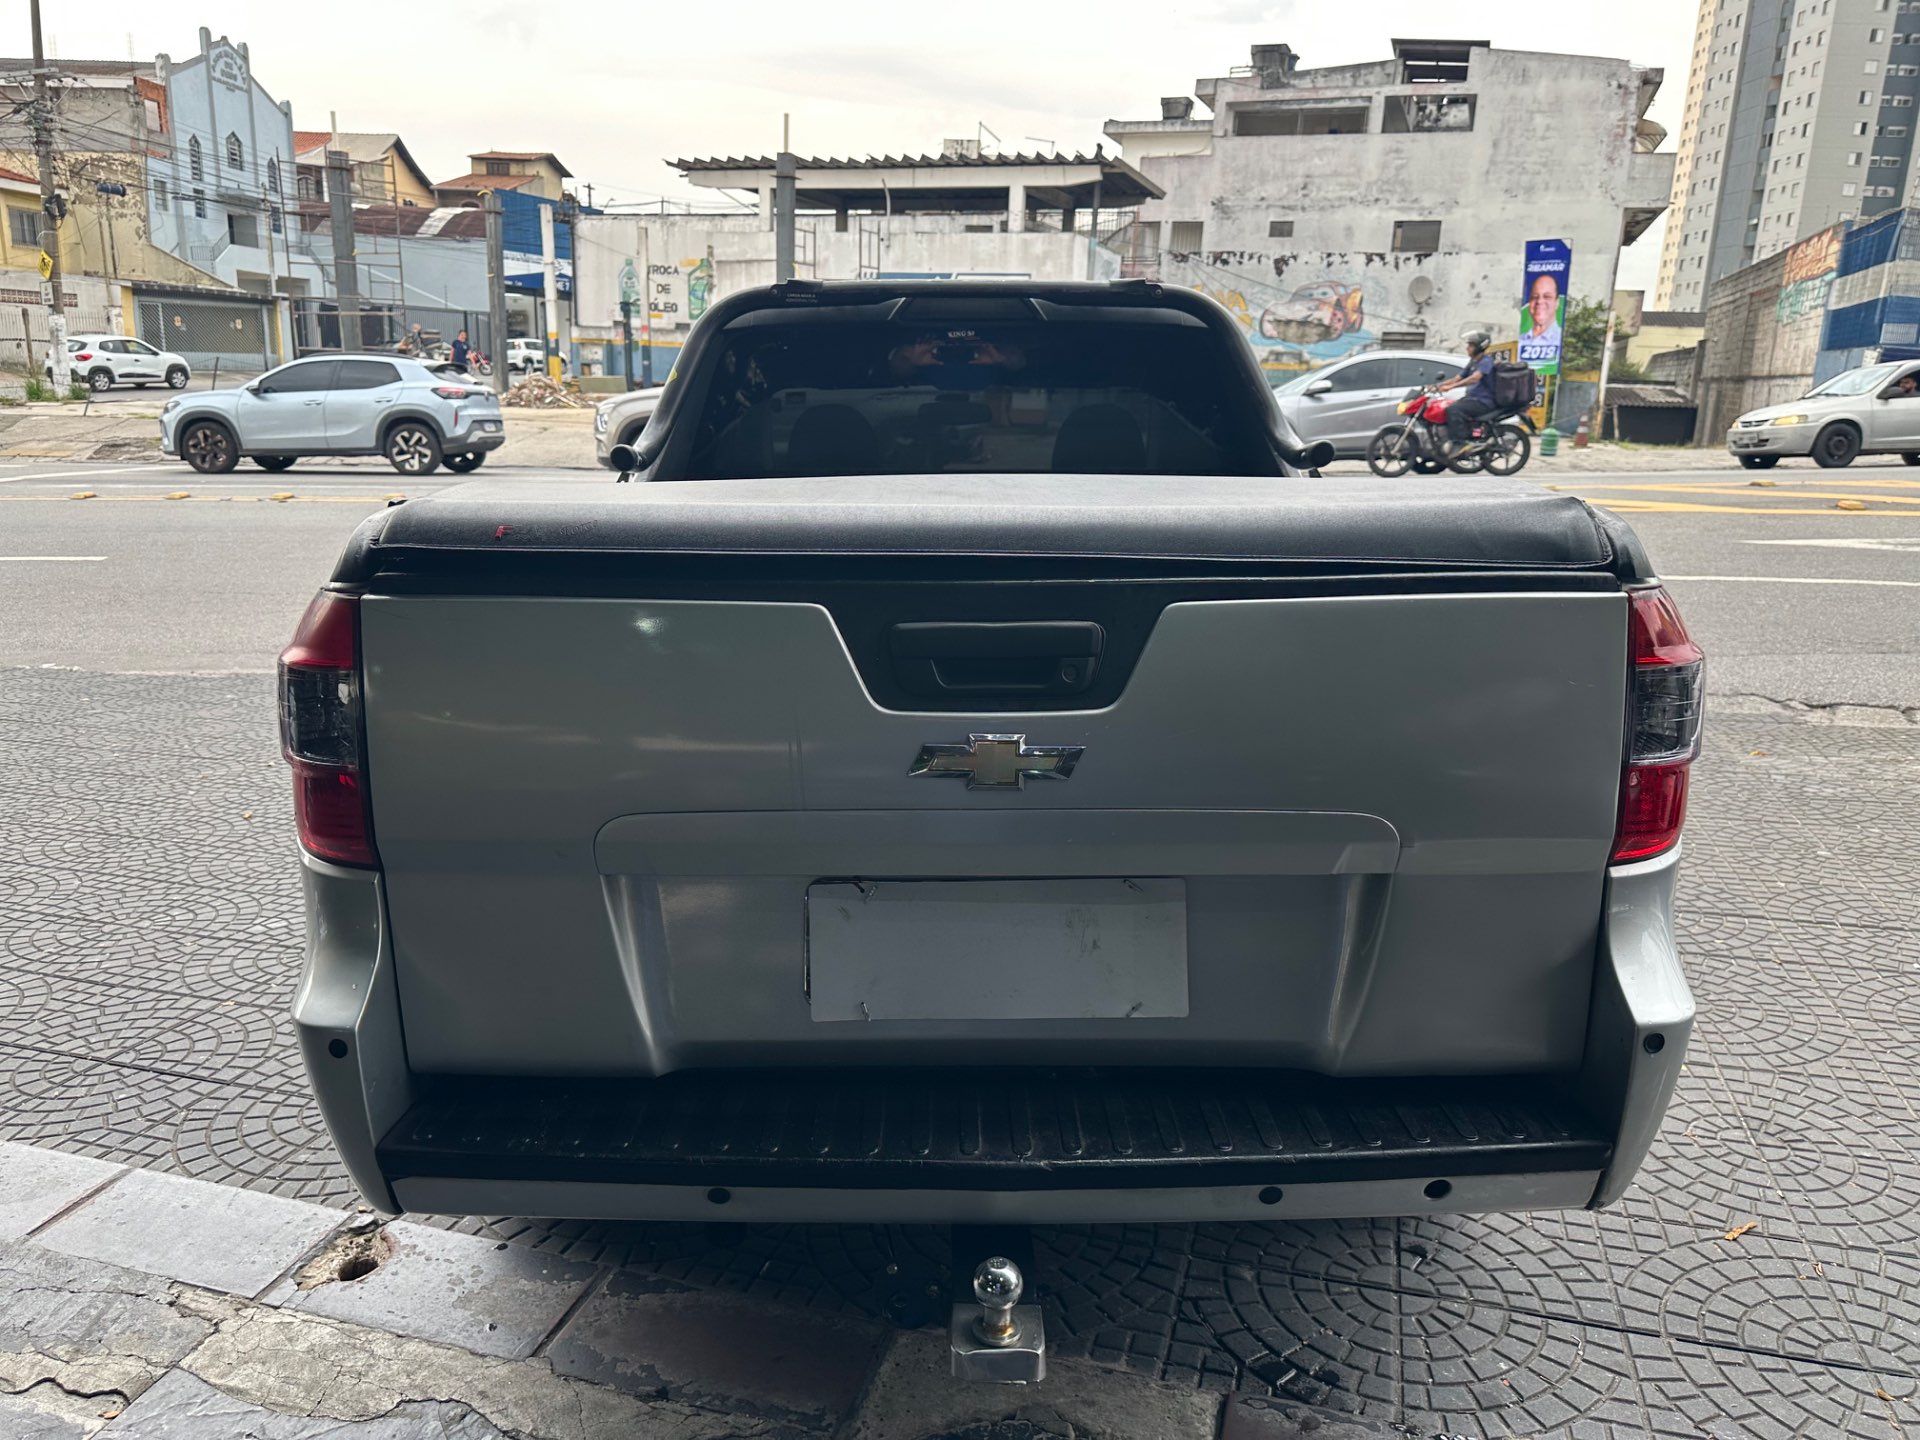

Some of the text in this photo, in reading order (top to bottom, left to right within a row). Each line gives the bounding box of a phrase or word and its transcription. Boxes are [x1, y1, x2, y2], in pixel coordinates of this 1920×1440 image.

[656, 283, 671, 294] DE
[649, 297, 678, 313] ÓLEO
[1521, 345, 1557, 359] 2019
